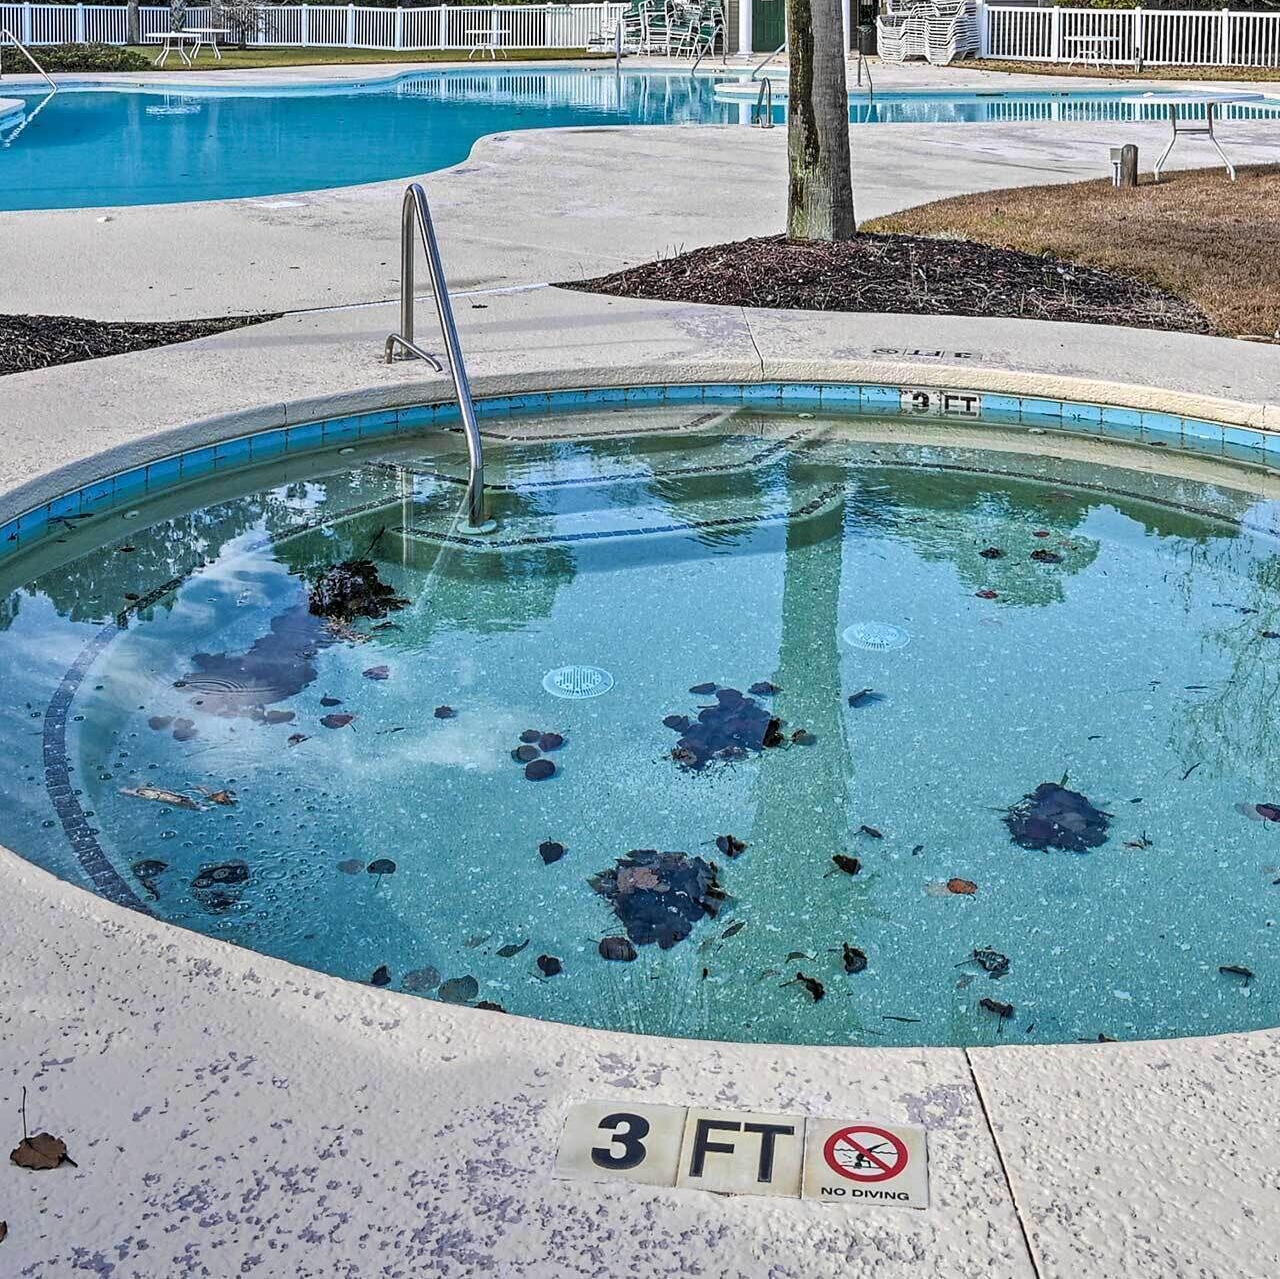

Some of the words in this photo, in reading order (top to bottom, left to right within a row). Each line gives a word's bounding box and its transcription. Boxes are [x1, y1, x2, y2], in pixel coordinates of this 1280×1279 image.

[945, 395, 977, 412] FT
[591, 1113, 650, 1170] 3
[689, 1119, 795, 1183] FT
[821, 1187, 846, 1196] NO
[852, 1189, 909, 1201] DIVING
